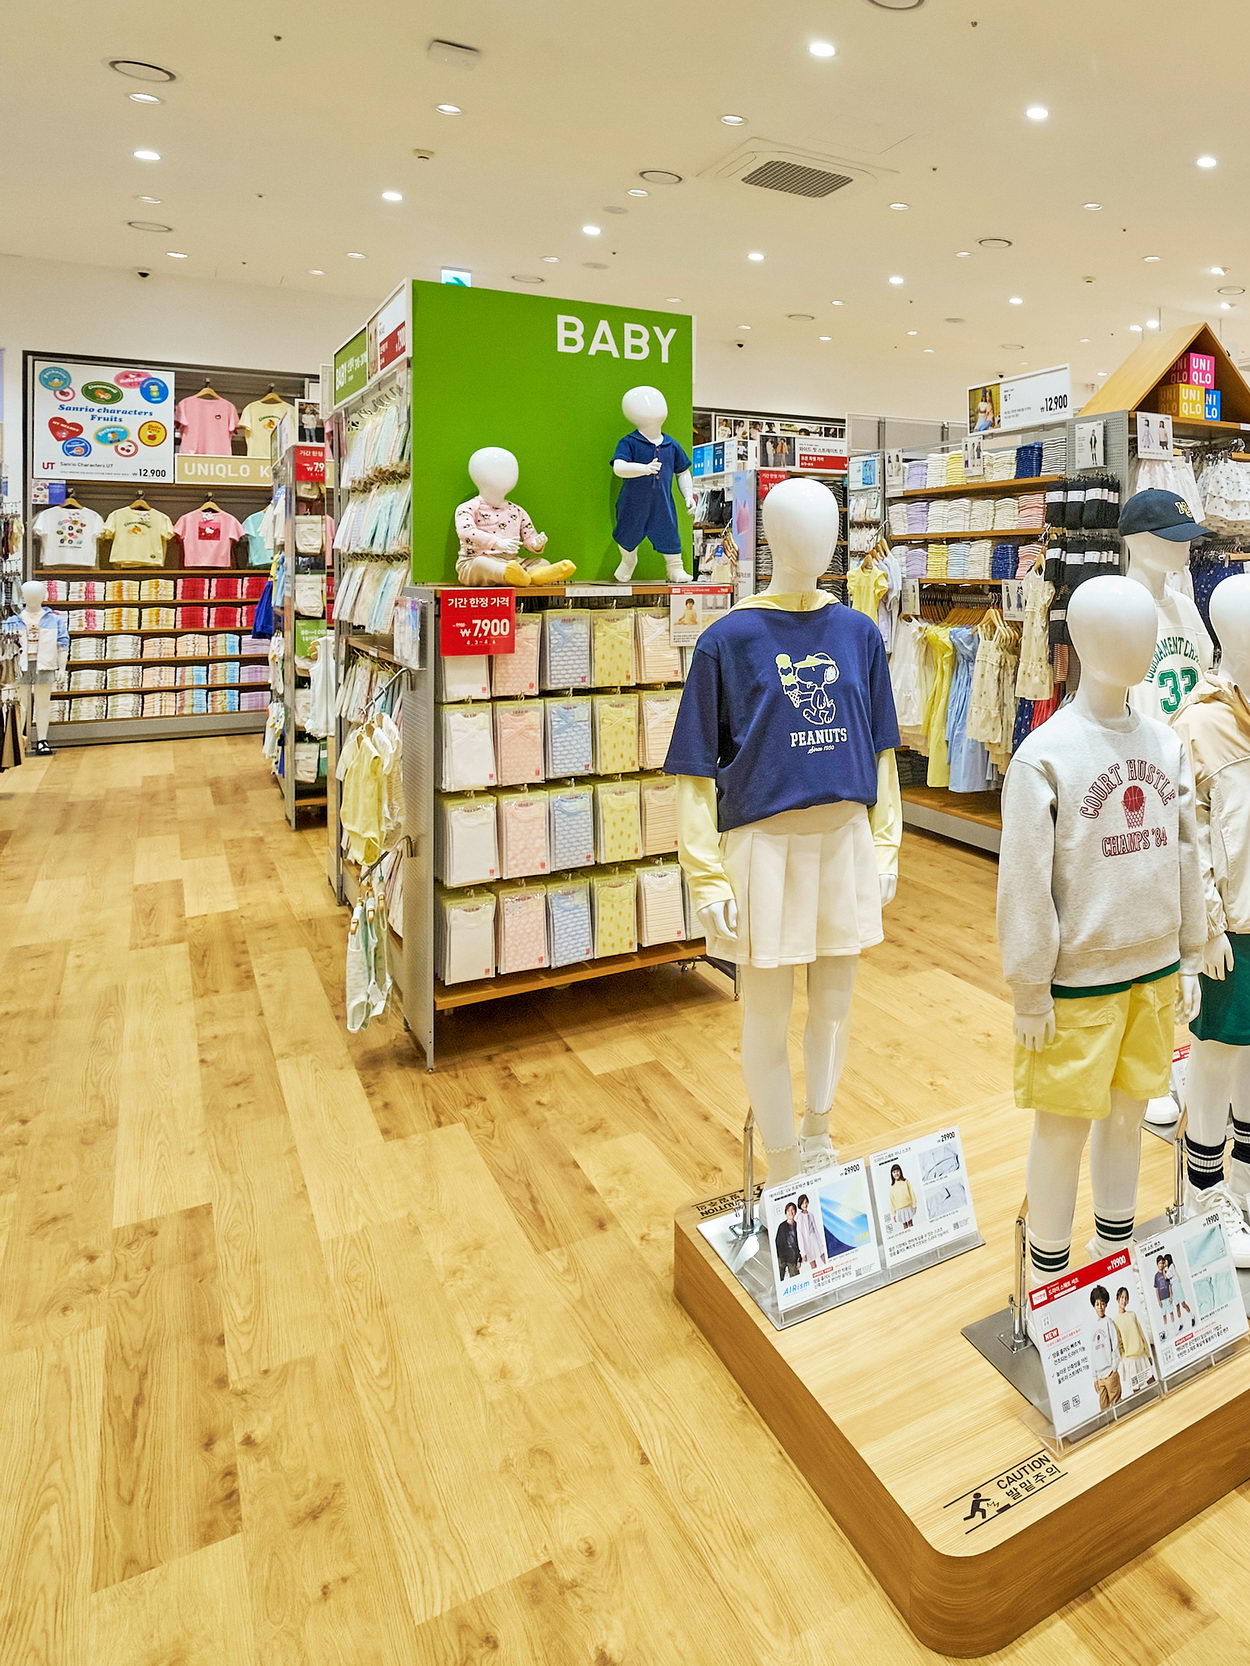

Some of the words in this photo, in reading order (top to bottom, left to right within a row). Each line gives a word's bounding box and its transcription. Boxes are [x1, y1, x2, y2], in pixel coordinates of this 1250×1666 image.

[557, 314, 677, 363] BABY
[1192, 357, 1211, 370] UNI
[1192, 371, 1212, 384] QLO
[1181, 388, 1200, 401] UNI
[58, 404, 95, 413] Sanrio
[97, 407, 153, 416] characters
[1181, 402, 1202, 415] QLO
[90, 414, 123, 422] Fruits
[42, 462, 56, 470] UT
[183, 462, 250, 479] UNIQLO
[448, 598, 467, 608] 기간
[469, 597, 488, 608] 한정
[491, 597, 509, 607] 가격
[790, 728, 847, 747] PEANUTS
[1080, 763, 1123, 820] COURT
[1126, 759, 1177, 806] HUSTLE
[1102, 829, 1150, 857] CHAMPS
[782, 1279, 809, 1295] AIRism
[1044, 1329, 1057, 1340] NEW
[996, 1454, 1050, 1490] CAUTION
